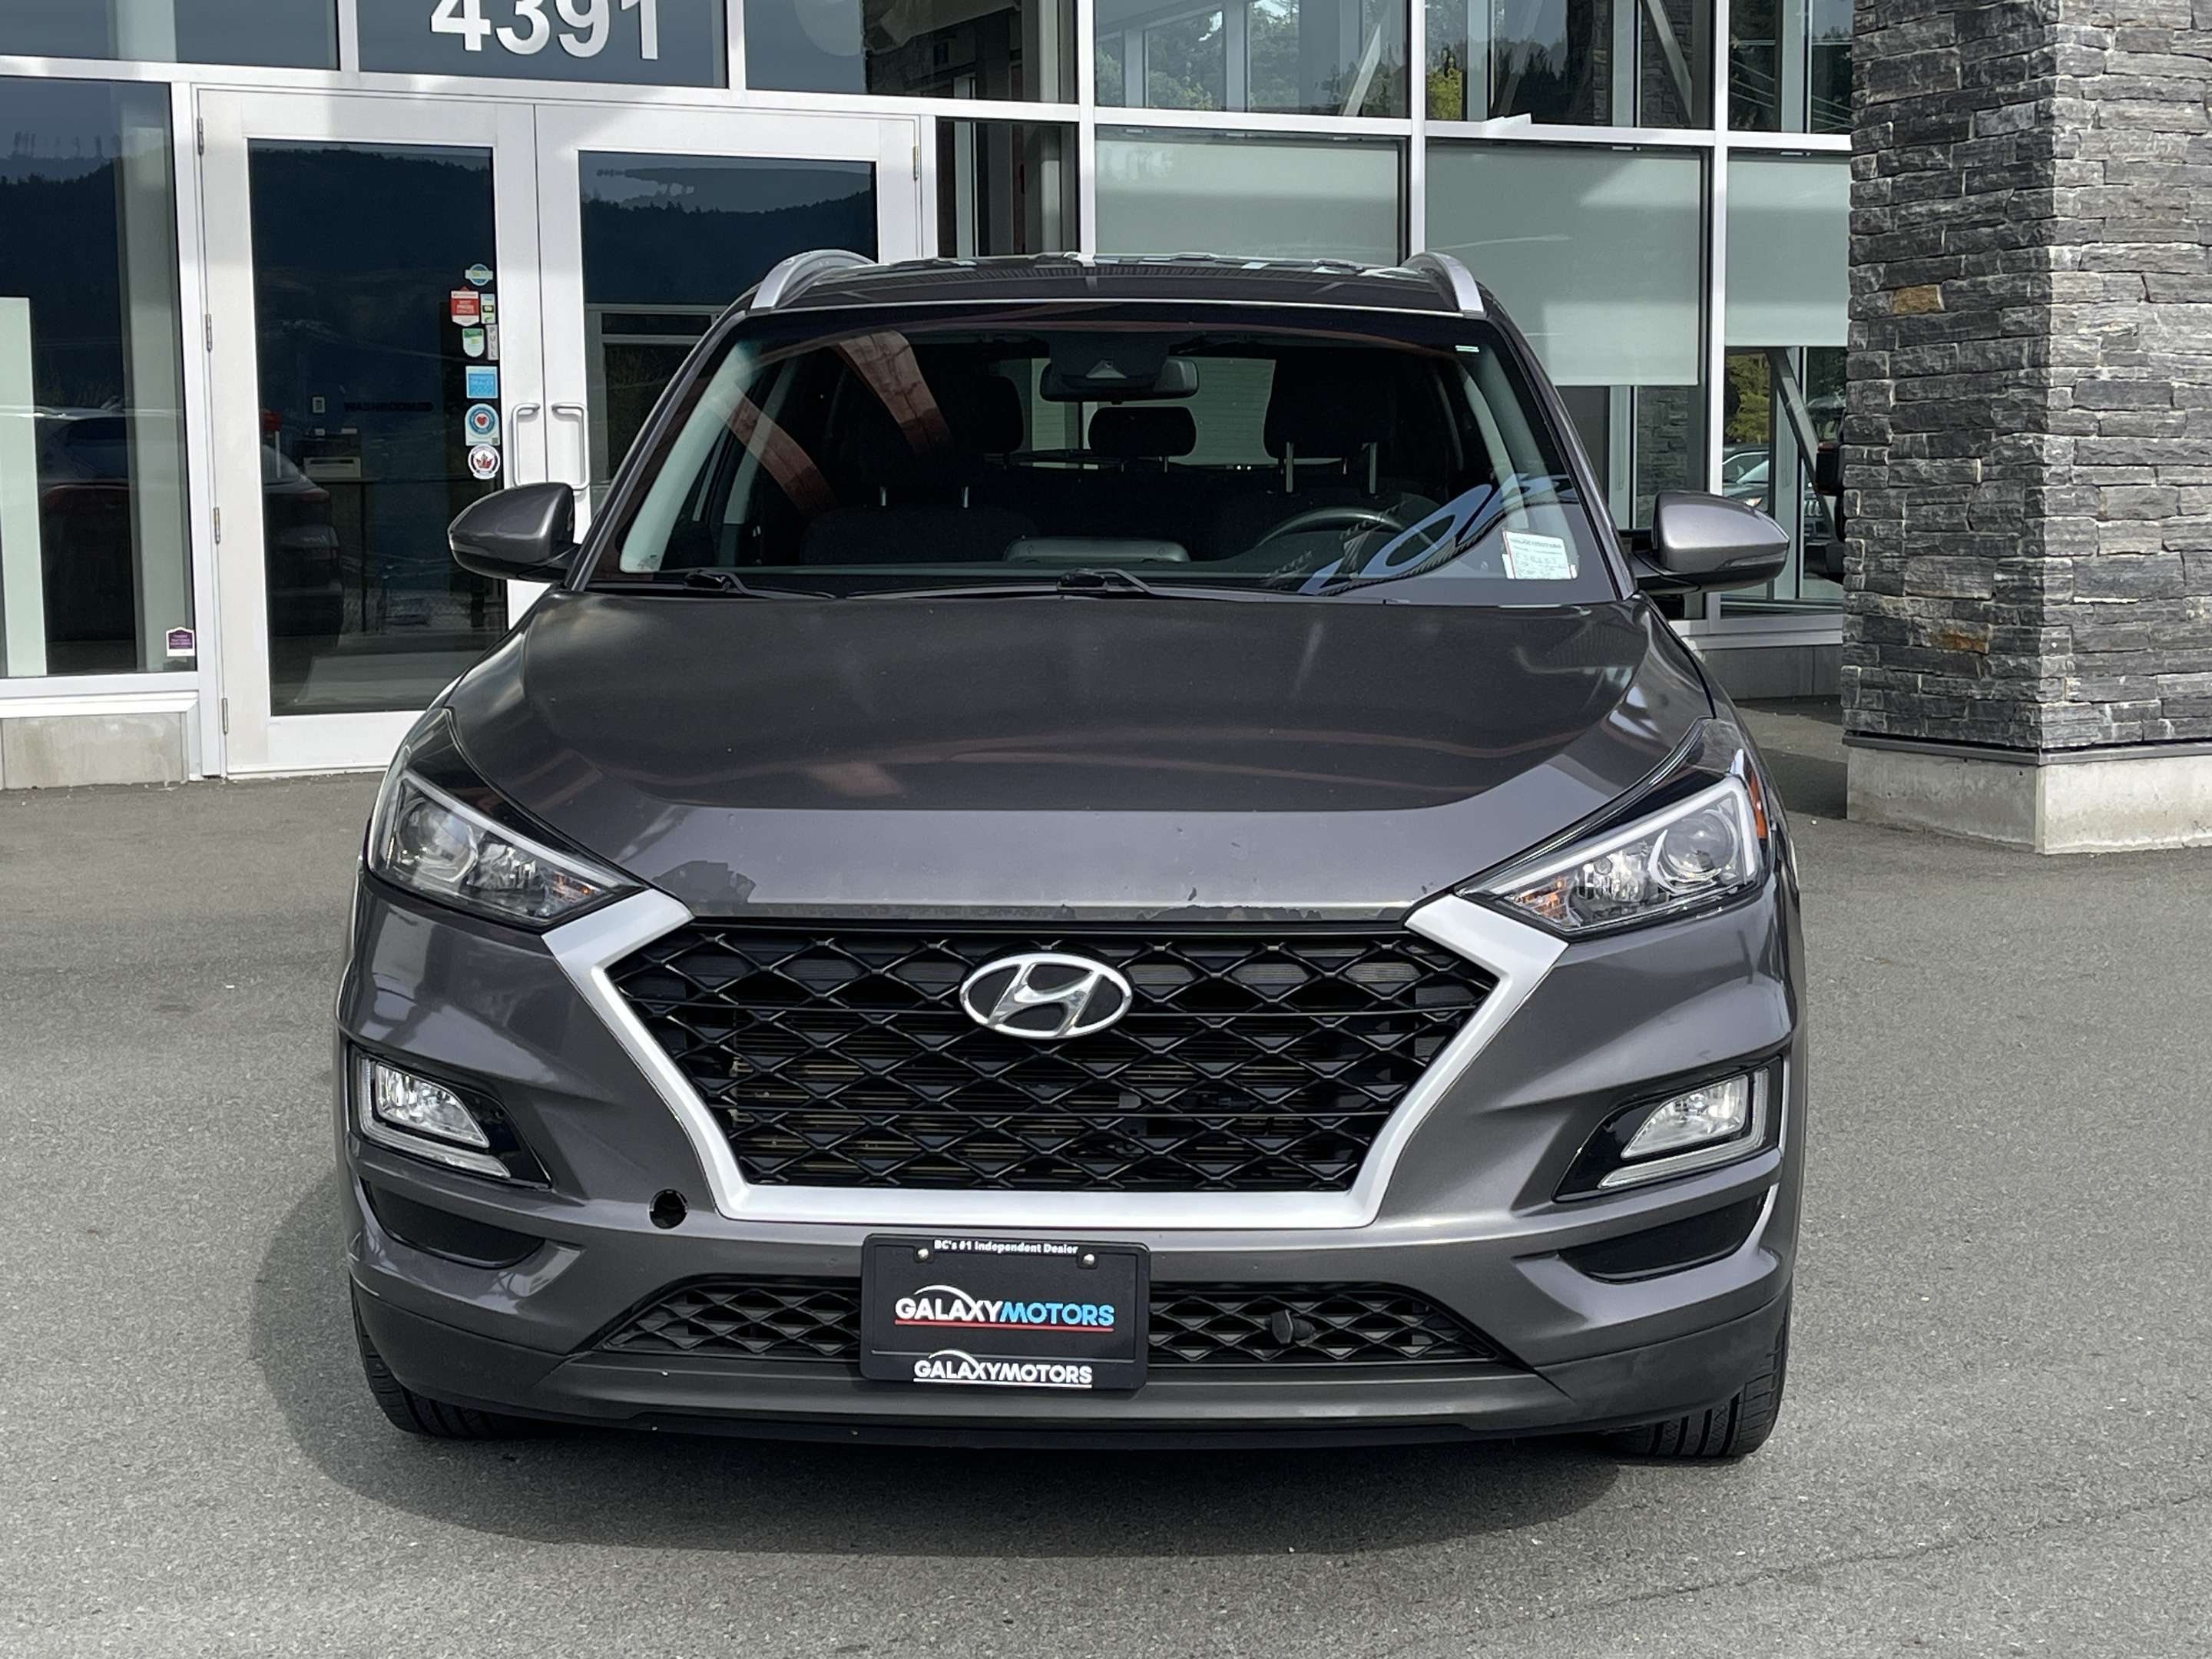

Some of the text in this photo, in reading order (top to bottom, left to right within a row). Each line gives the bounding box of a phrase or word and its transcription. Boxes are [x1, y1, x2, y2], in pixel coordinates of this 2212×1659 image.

[430, 0, 659, 60] 4391
[934, 1239, 1079, 1253] BC's #1 Independent Dealer
